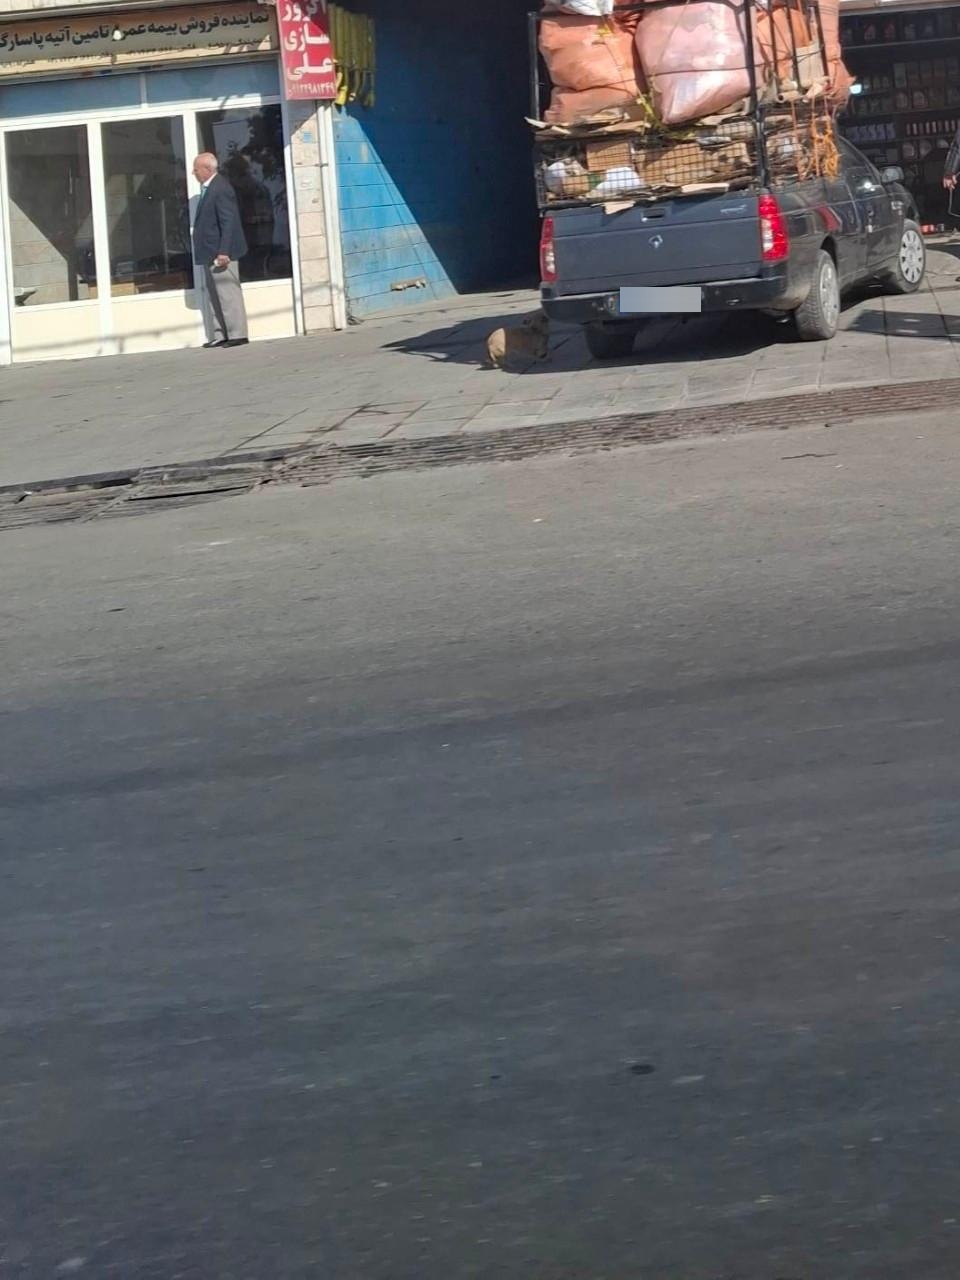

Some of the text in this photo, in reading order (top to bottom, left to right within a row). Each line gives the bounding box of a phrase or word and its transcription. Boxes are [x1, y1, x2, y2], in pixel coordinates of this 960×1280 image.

[147, 21, 177, 37] بیمه
[178, 12, 220, 35] فروش
[221, 11, 270, 28] نماینده
[121, 22, 145, 40] عمر
[284, 22, 330, 52] سازی
[286, 51, 333, 81] علی
